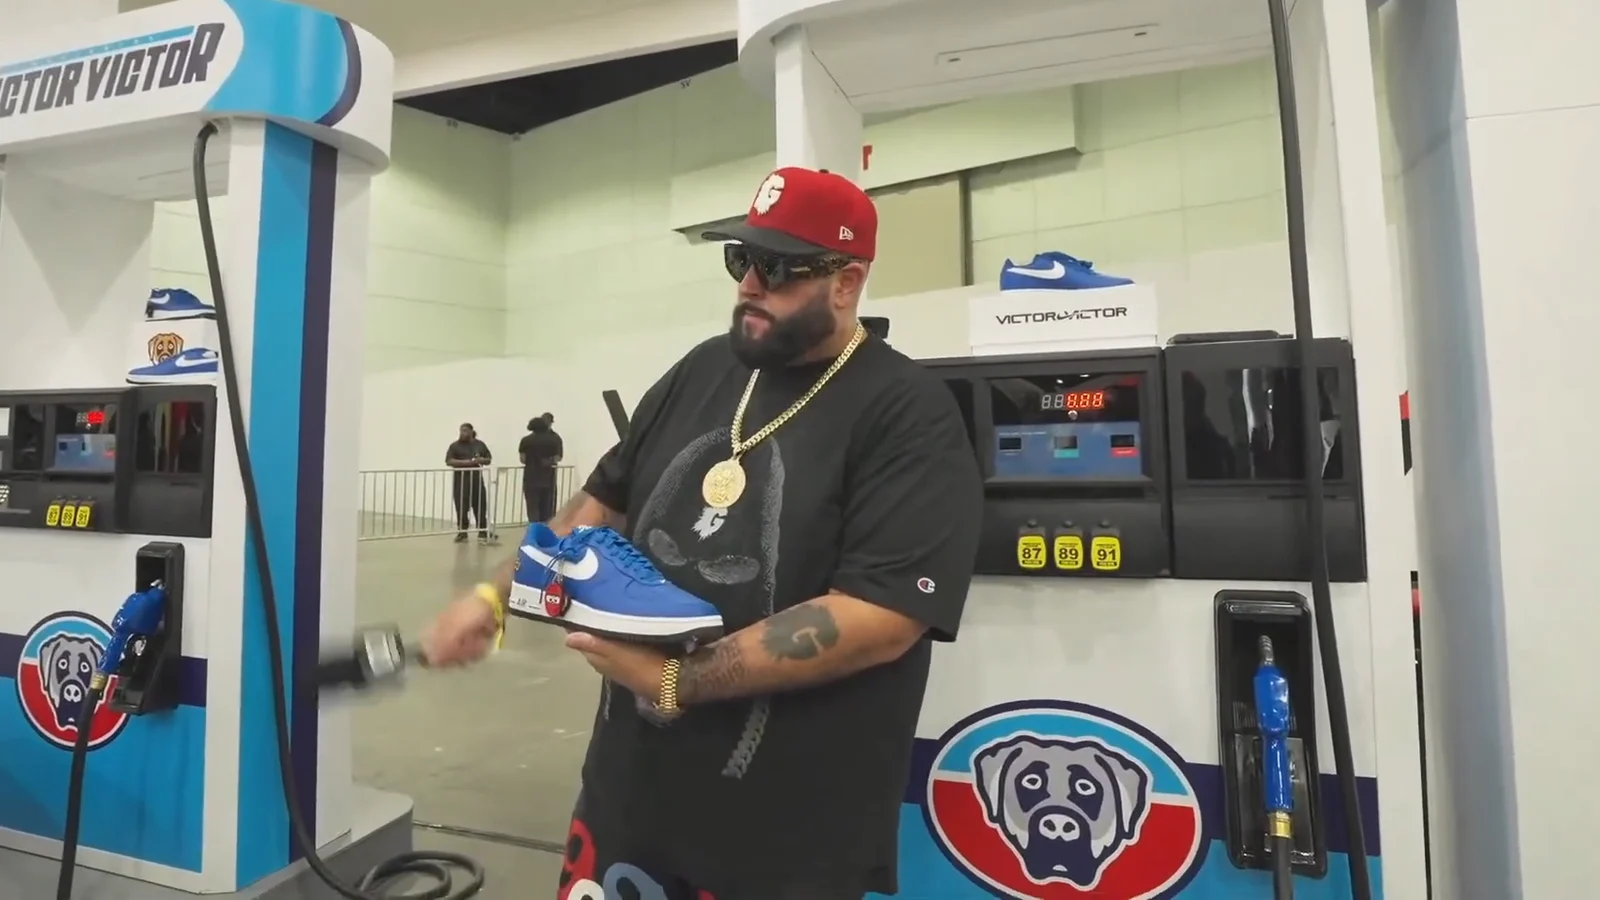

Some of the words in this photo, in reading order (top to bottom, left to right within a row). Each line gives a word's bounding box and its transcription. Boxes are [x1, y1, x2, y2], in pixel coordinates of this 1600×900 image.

[0, 61, 84, 117] CTOR
[86, 22, 225, 102] VICTOR
[1022, 547, 1042, 559] 87
[1058, 547, 1079, 560] 89
[1097, 548, 1117, 561] 91
